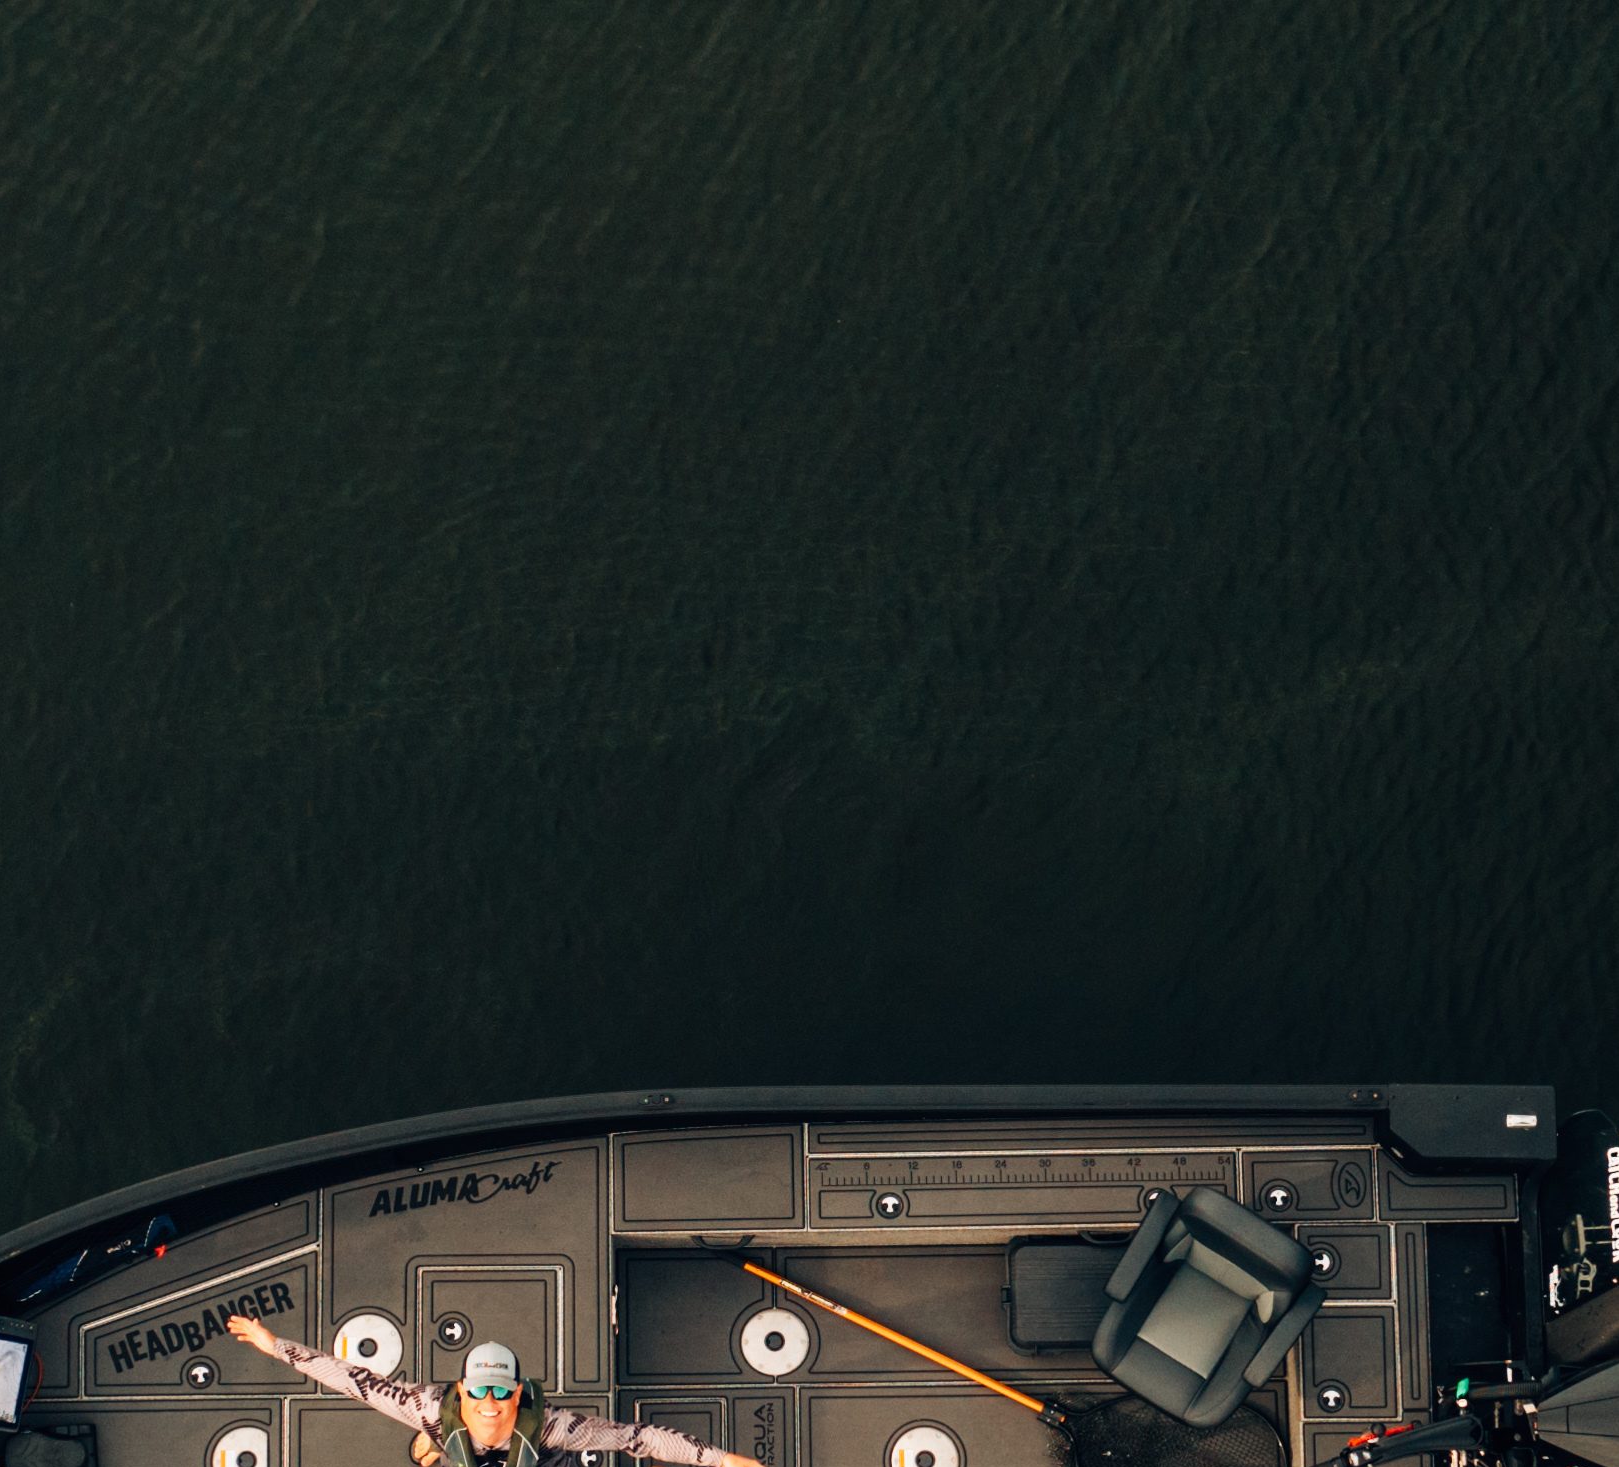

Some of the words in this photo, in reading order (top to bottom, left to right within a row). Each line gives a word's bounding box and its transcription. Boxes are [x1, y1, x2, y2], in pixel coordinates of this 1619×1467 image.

[907, 1161, 919, 1170] 12
[952, 1160, 962, 1169] 18
[995, 1160, 1006, 1168] 24
[1039, 1159, 1051, 1167] 30
[1127, 1158, 1141, 1166] 42
[1173, 1157, 1187, 1165] 48
[1218, 1156, 1231, 1165] 54
[753, 1404, 766, 1466] QUA
